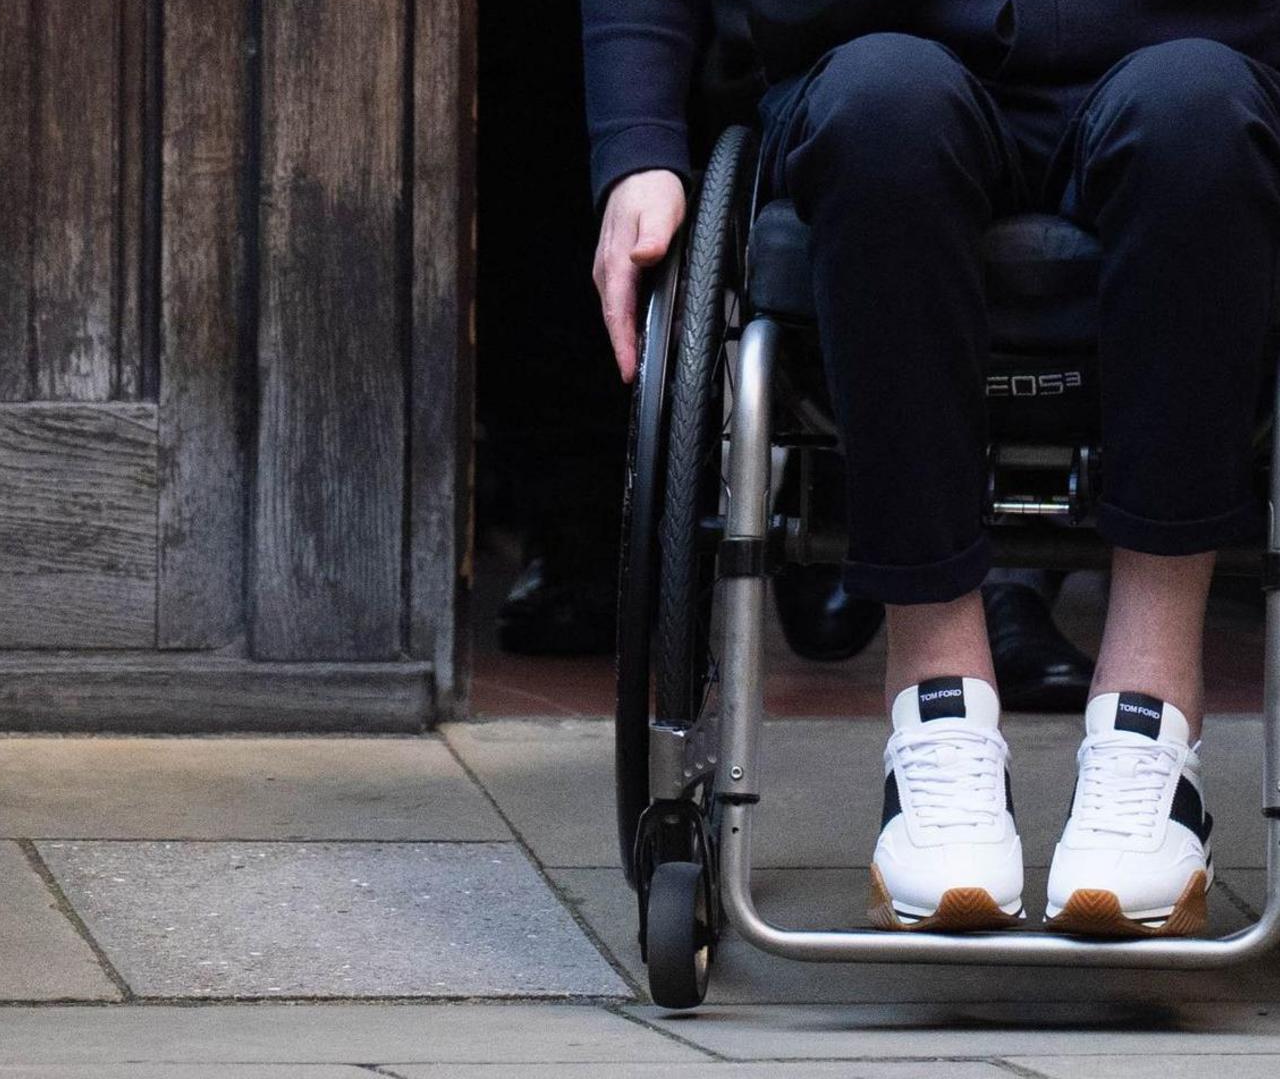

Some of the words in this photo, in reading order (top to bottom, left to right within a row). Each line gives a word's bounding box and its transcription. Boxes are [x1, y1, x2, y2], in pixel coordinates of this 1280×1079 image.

[920, 692, 938, 702] TOM
[938, 688, 962, 699] FORD
[1120, 703, 1138, 713] TOM
[1138, 706, 1161, 720] FORD
